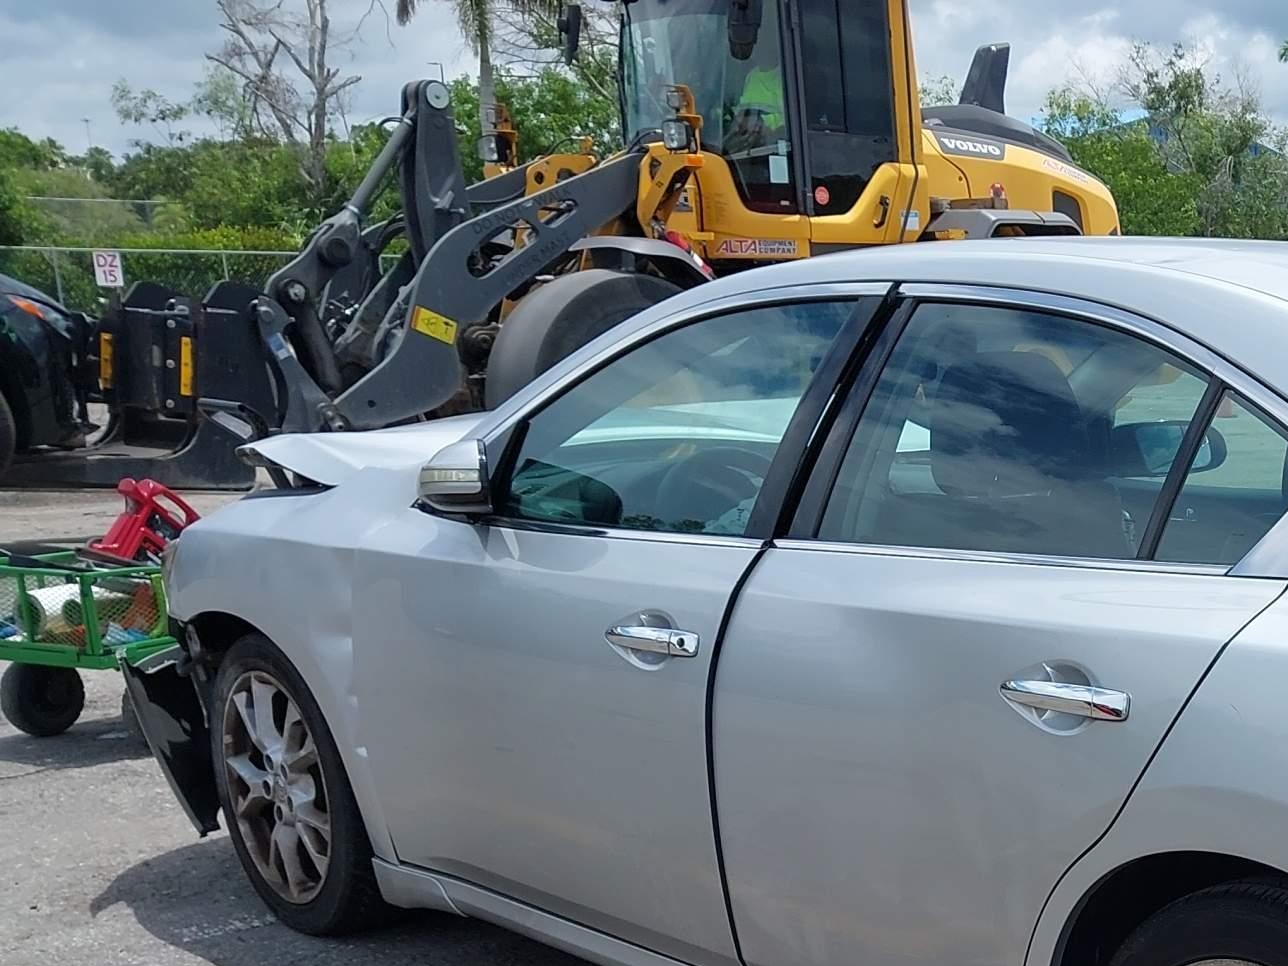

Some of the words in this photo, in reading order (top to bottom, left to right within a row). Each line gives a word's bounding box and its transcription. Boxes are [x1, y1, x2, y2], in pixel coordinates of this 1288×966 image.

[940, 138, 1000, 155] VOLVO
[716, 240, 757, 253] ALTA
[96, 254, 118, 267] DZ
[103, 270, 118, 283] 15
